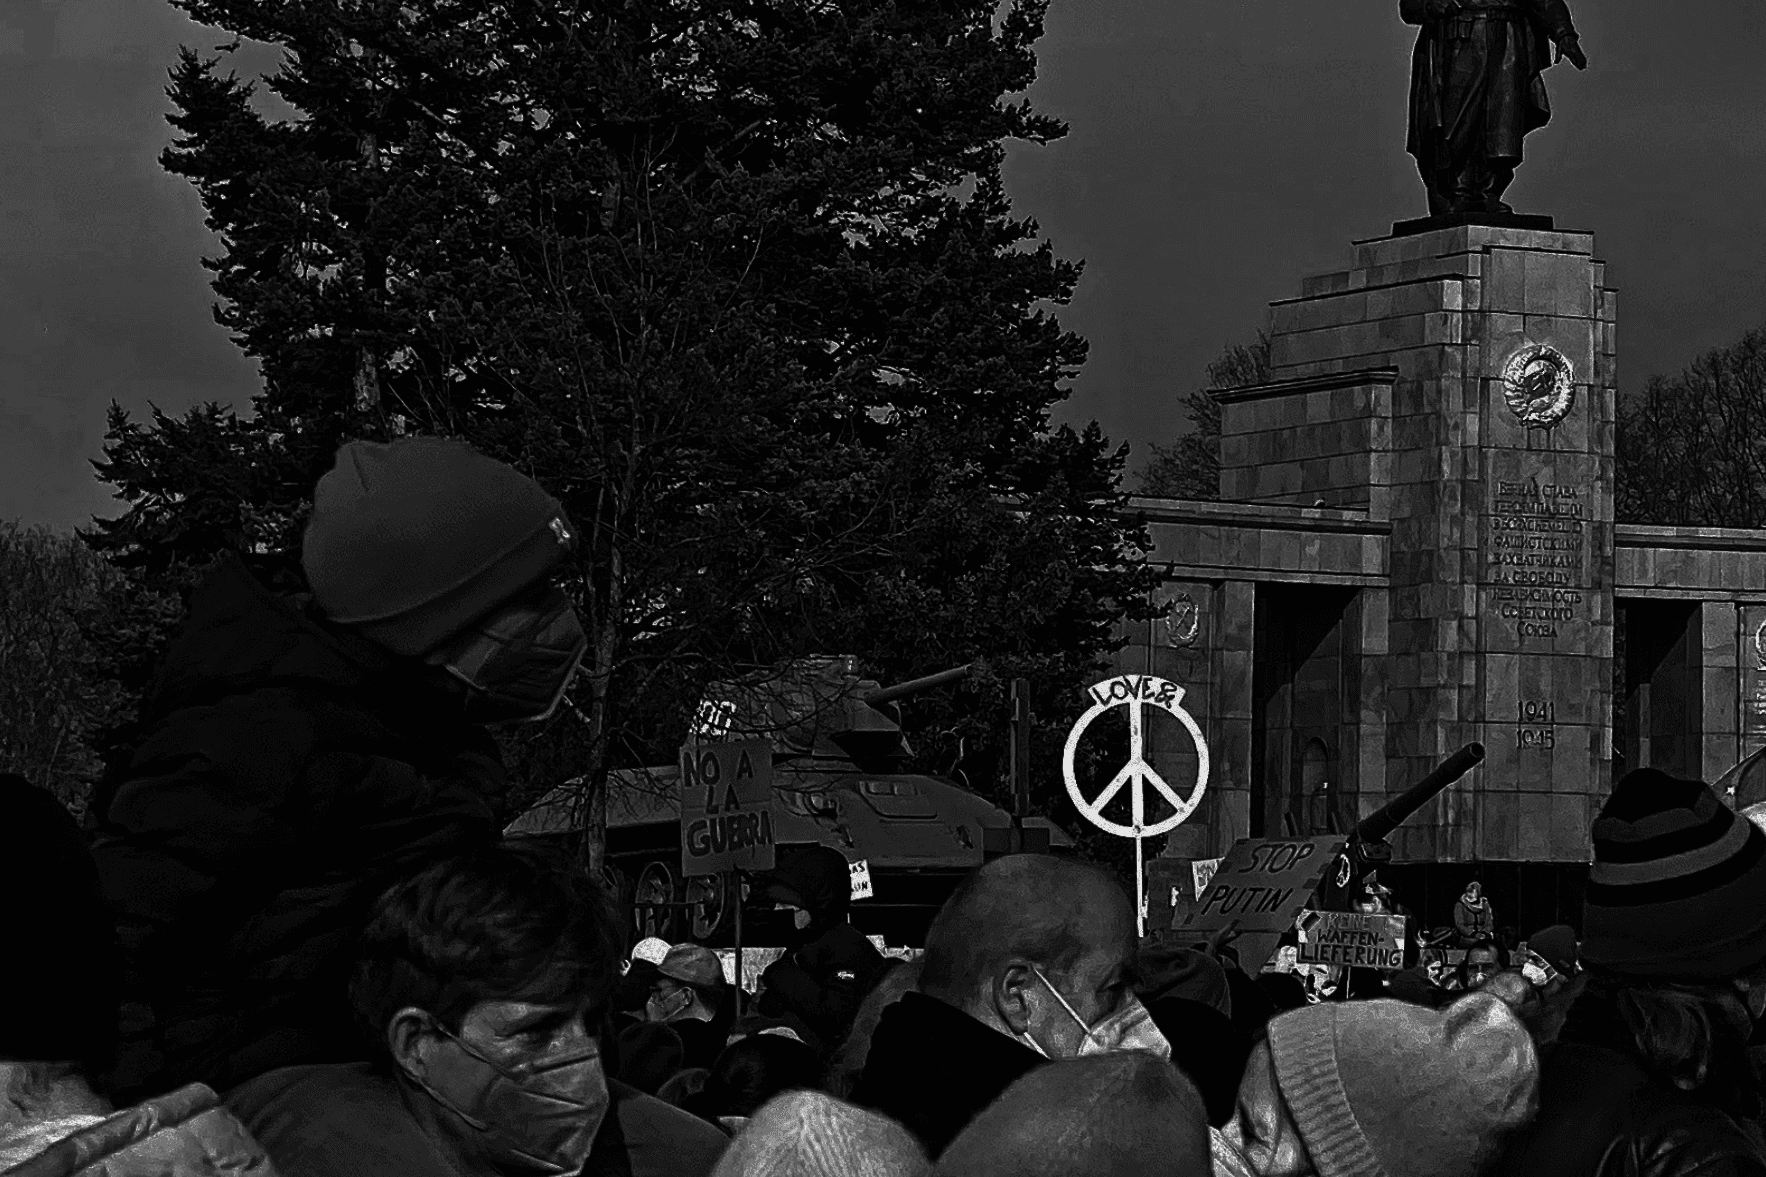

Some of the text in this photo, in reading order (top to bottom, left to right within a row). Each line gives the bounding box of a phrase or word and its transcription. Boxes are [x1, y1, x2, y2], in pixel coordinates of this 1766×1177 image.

[1518, 700, 1555, 722] 1941
[1516, 728, 1555, 750] 1945
[683, 749, 753, 787] NO A
[706, 783, 740, 814] LA
[687, 810, 772, 858] GUERRA
[1238, 843, 1315, 874] STOP
[1201, 885, 1293, 915] PUTIN
[1317, 928, 1385, 945] WAFFEN-
[1301, 943, 1401, 966] LIEFERUNG
